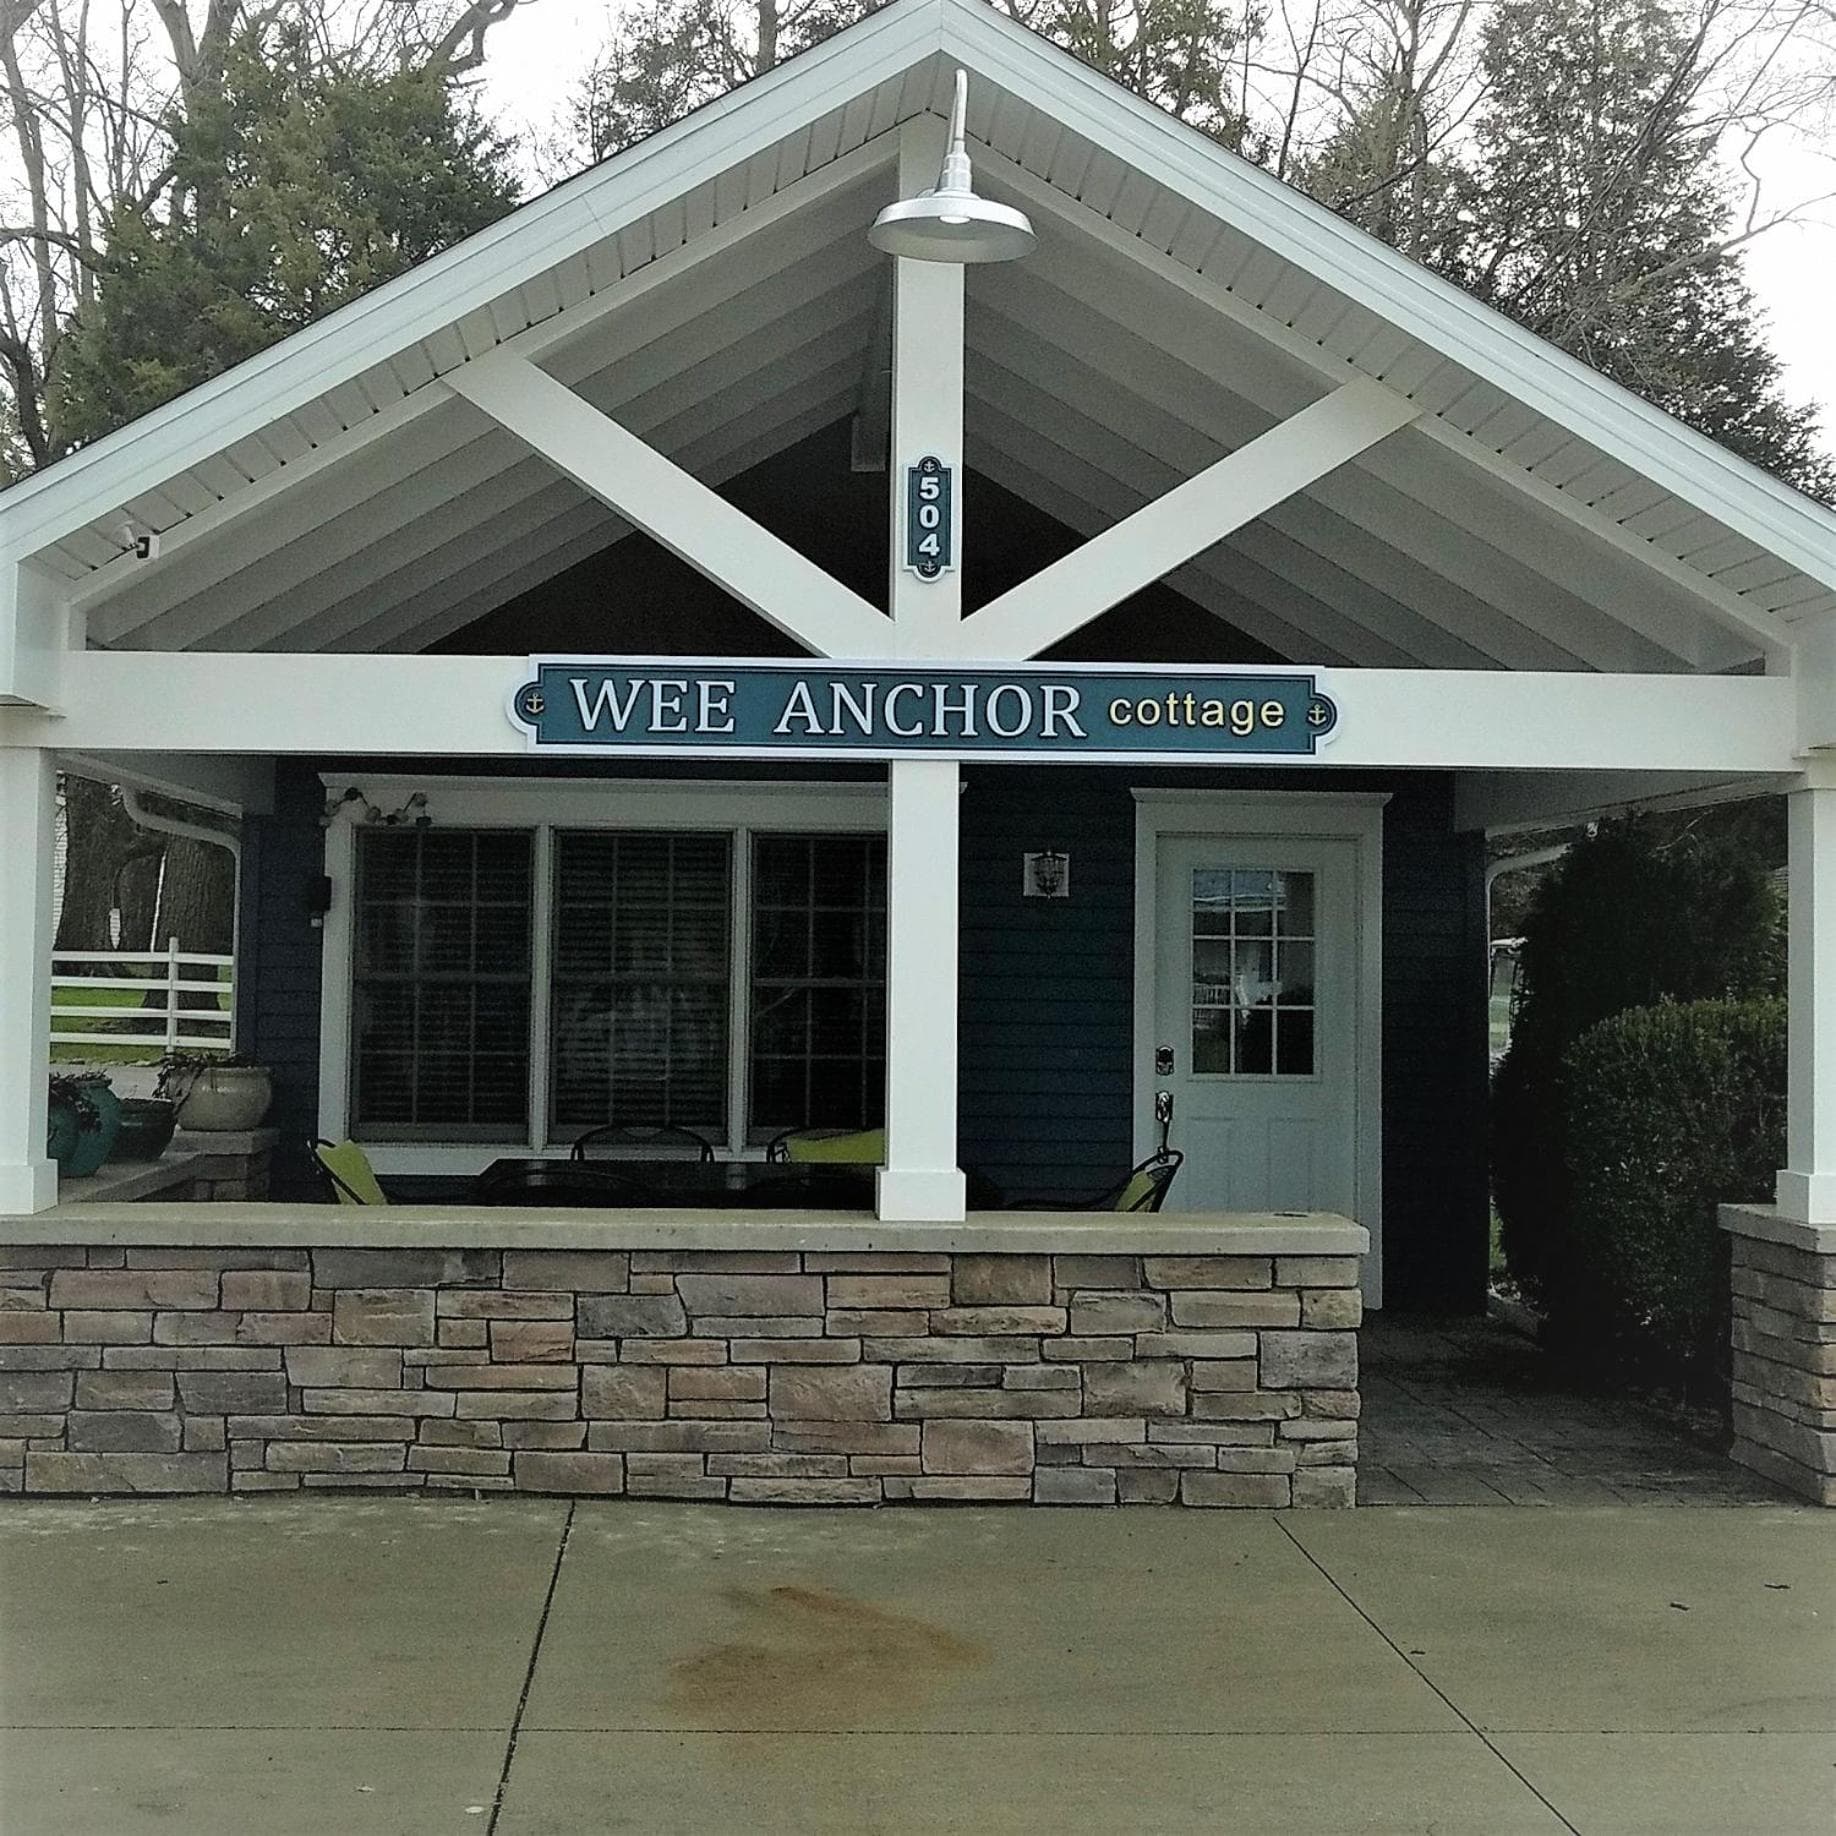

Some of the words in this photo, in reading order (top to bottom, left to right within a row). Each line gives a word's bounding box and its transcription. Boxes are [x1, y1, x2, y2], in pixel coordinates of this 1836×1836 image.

[918, 476, 941, 556] 504
[569, 678, 736, 732] WEE
[772, 681, 1088, 738] ANCHOR
[1109, 691, 1285, 736] cottage
